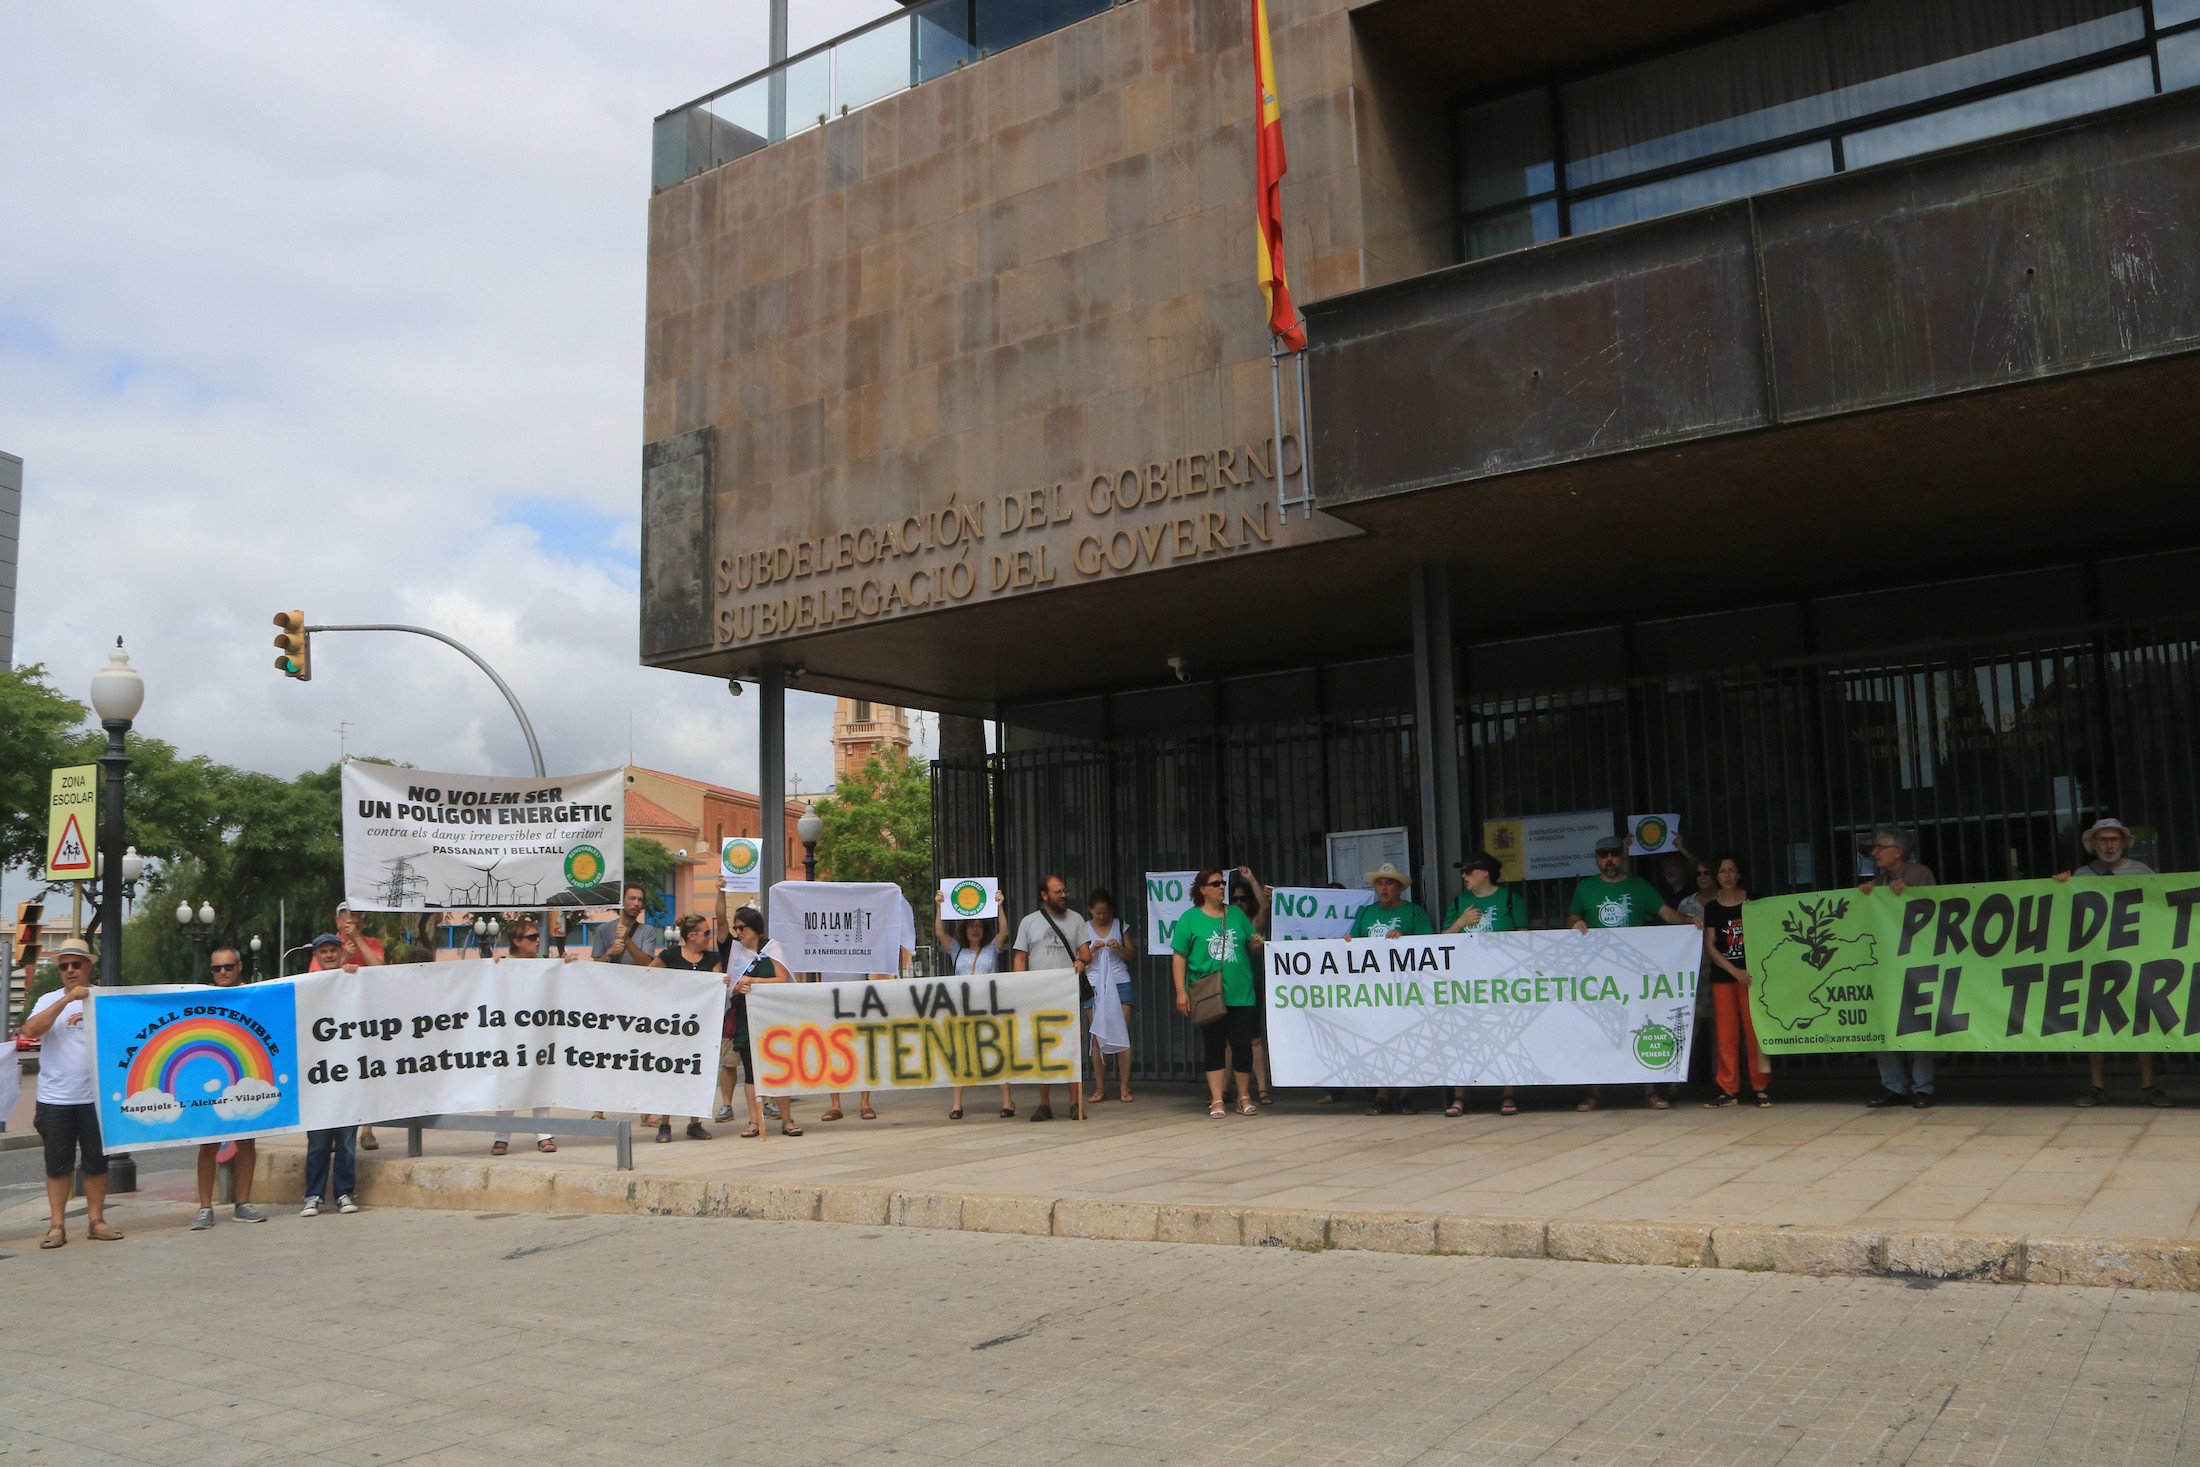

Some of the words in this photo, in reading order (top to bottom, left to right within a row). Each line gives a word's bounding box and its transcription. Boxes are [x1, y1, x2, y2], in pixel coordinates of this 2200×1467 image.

[718, 491, 985, 595] SUBDELEGACIÓN
[999, 484, 1073, 535] DEL
[1086, 434, 1303, 515] GOBIERNO
[717, 546, 976, 644] SUBDELEGACIÓ
[989, 545, 1057, 592] DEL
[1072, 501, 1273, 575] GOVERN
[62, 775, 85, 788] ZONA
[52, 791, 94, 806] ESCOLAR
[408, 785, 441, 803] NO
[447, 789, 520, 807] VOLEM
[524, 786, 563, 804] SER
[358, 799, 392, 819] UN
[397, 803, 492, 825] POLÍGON
[498, 801, 612, 825] ENERGÈTIC
[366, 827, 408, 838] contra
[412, 826, 428, 838] els
[432, 828, 466, 844] danys
[470, 829, 541, 842] irreversibles
[545, 828, 556, 840] al
[561, 827, 604, 840] territori
[433, 845, 498, 856] PASSANANT
[503, 847, 507, 856] I
[511, 846, 564, 856] BELLTALL
[1147, 879, 1183, 902] NO
[1275, 891, 1318, 918] NO
[1324, 904, 1338, 919] A
[804, 911, 818, 931] NO
[820, 911, 827, 931] A
[829, 911, 841, 931] LA
[1897, 893, 2054, 957] PROU
[2068, 888, 2144, 953] DE
[804, 948, 811, 956] SI
[812, 948, 817, 956] A
[818, 948, 848, 956] ENERGIES
[848, 948, 872, 956] LOCALS
[1274, 951, 1312, 976] NO
[1320, 951, 1339, 975] A
[1347, 949, 1381, 974] LA
[1389, 946, 1456, 972] MAT
[832, 985, 889, 1019] LA
[909, 979, 1015, 1019] VALL
[1275, 981, 1425, 1009] SOBIRANIA
[1433, 970, 1629, 1005] ENERGÈTICA,
[1639, 970, 1696, 1000] JA!!
[1826, 984, 1875, 1002] XARXA
[1896, 964, 1970, 1037] EL
[312, 1017, 403, 1042] Grup
[411, 1011, 469, 1039] per
[477, 1004, 506, 1028] la
[514, 1009, 700, 1037] conservació
[1837, 1008, 1868, 1026] SUD
[118, 1045, 139, 1070] LA
[135, 1011, 180, 1041] VALL
[183, 1005, 280, 1057] SOSTENIBLE
[761, 1012, 1072, 1087] SOSTENIBLE
[1762, 1032, 1886, 1046] comunicacio@xarxasud.org
[307, 1059, 349, 1085] de
[357, 1055, 387, 1080] la
[396, 1049, 510, 1075] natura
[517, 1044, 528, 1067] i
[535, 1042, 556, 1066] el
[564, 1046, 702, 1076] territori
[1640, 1050, 1671, 1058] PENEDÈS
[120, 1101, 172, 1114] Maspujols
[234, 1090, 282, 1103] Vilaplana
